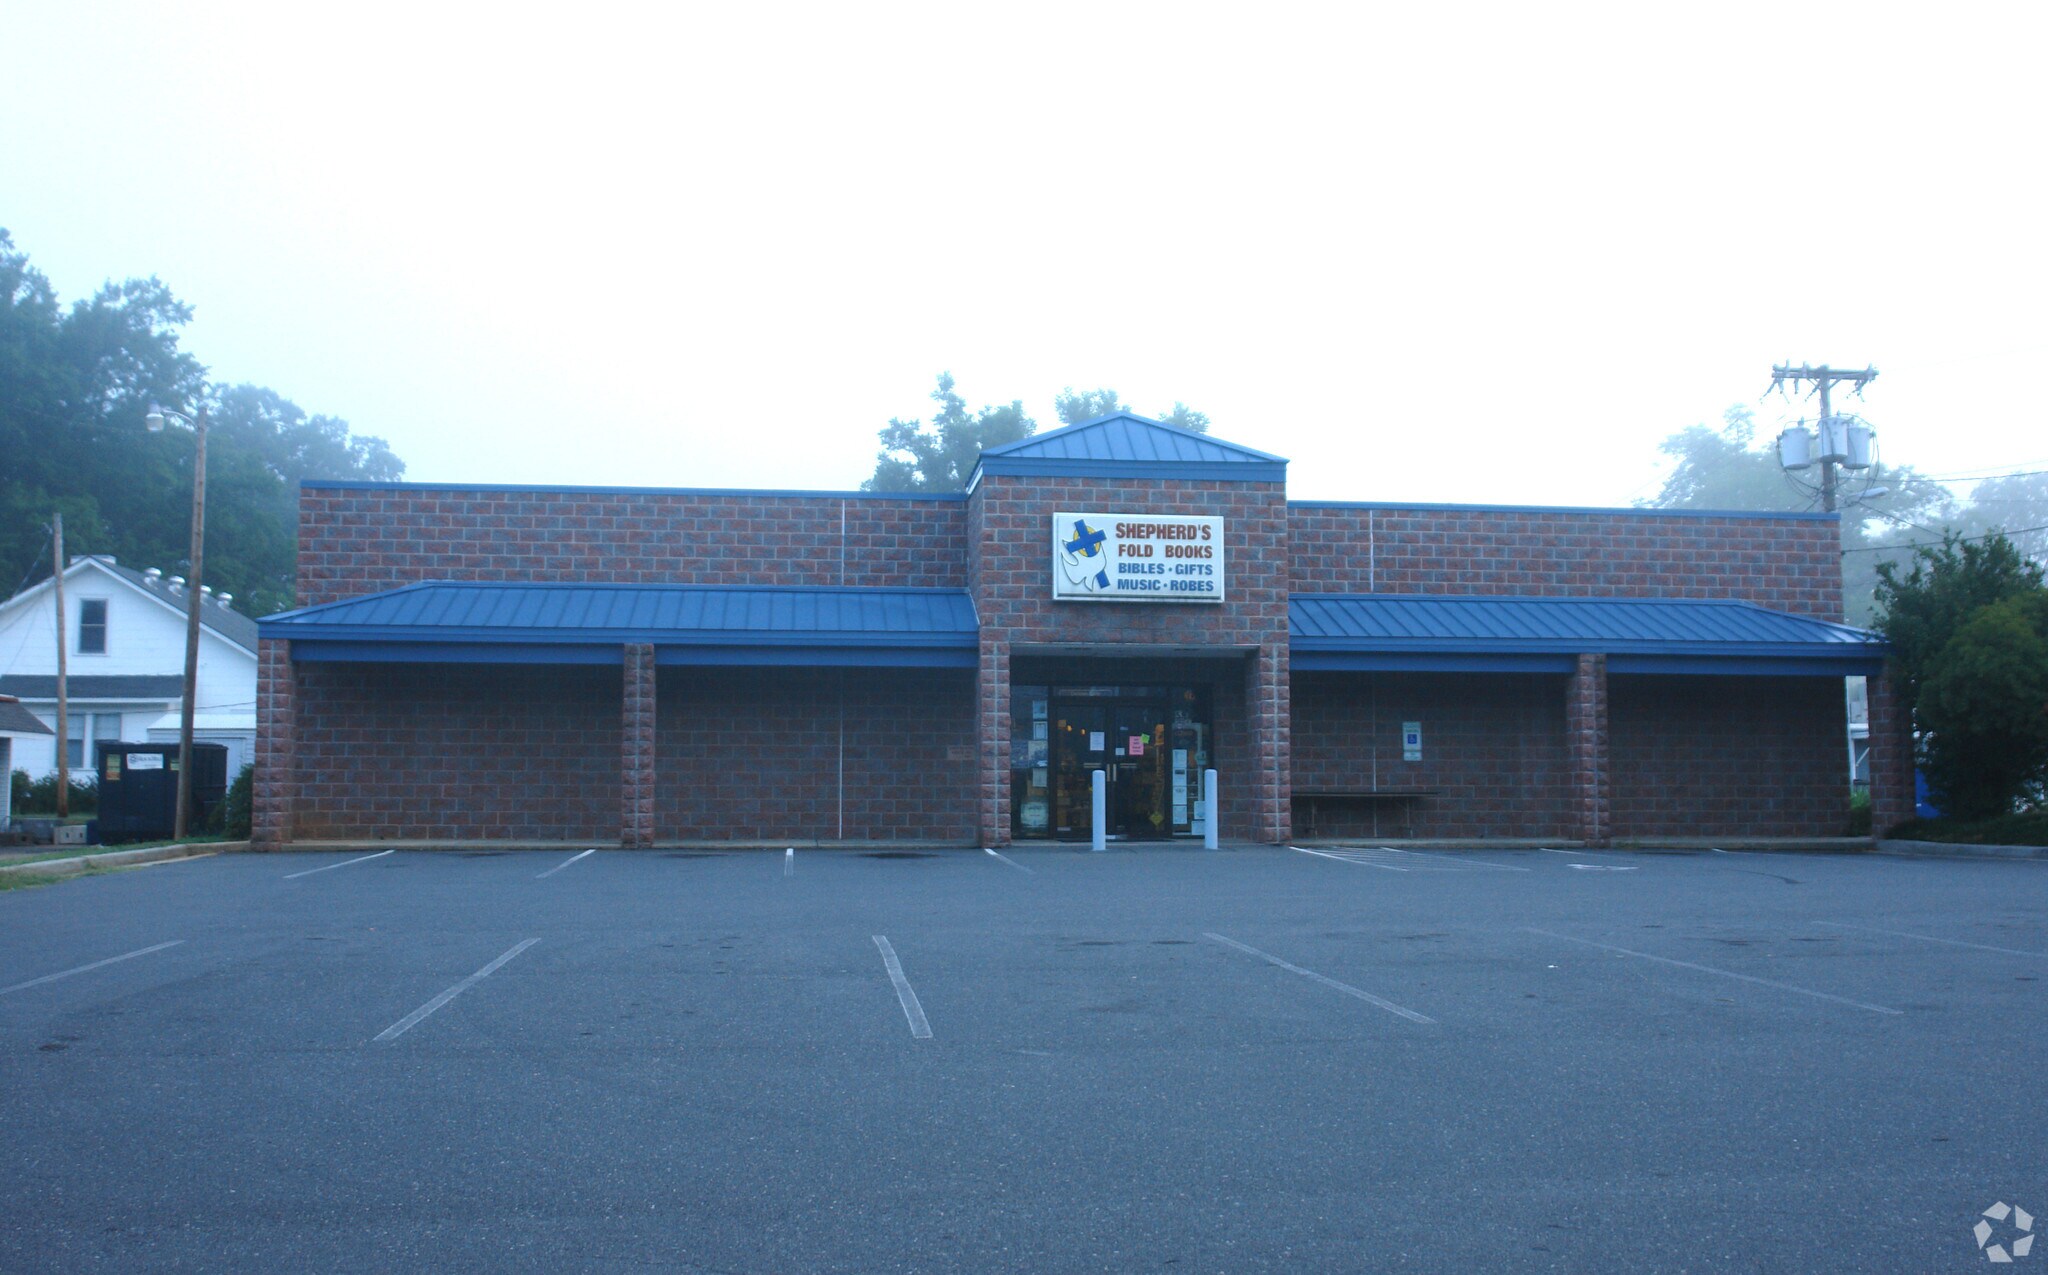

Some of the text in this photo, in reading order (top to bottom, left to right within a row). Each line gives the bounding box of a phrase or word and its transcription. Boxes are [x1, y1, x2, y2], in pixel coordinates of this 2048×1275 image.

[1115, 522, 1212, 541] SHEPHERD'S
[1118, 543, 1213, 559] FOLD BOOKS
[1118, 562, 1213, 576] BIBLES GIFTS
[1117, 578, 1214, 592] MUSIC ROBES
